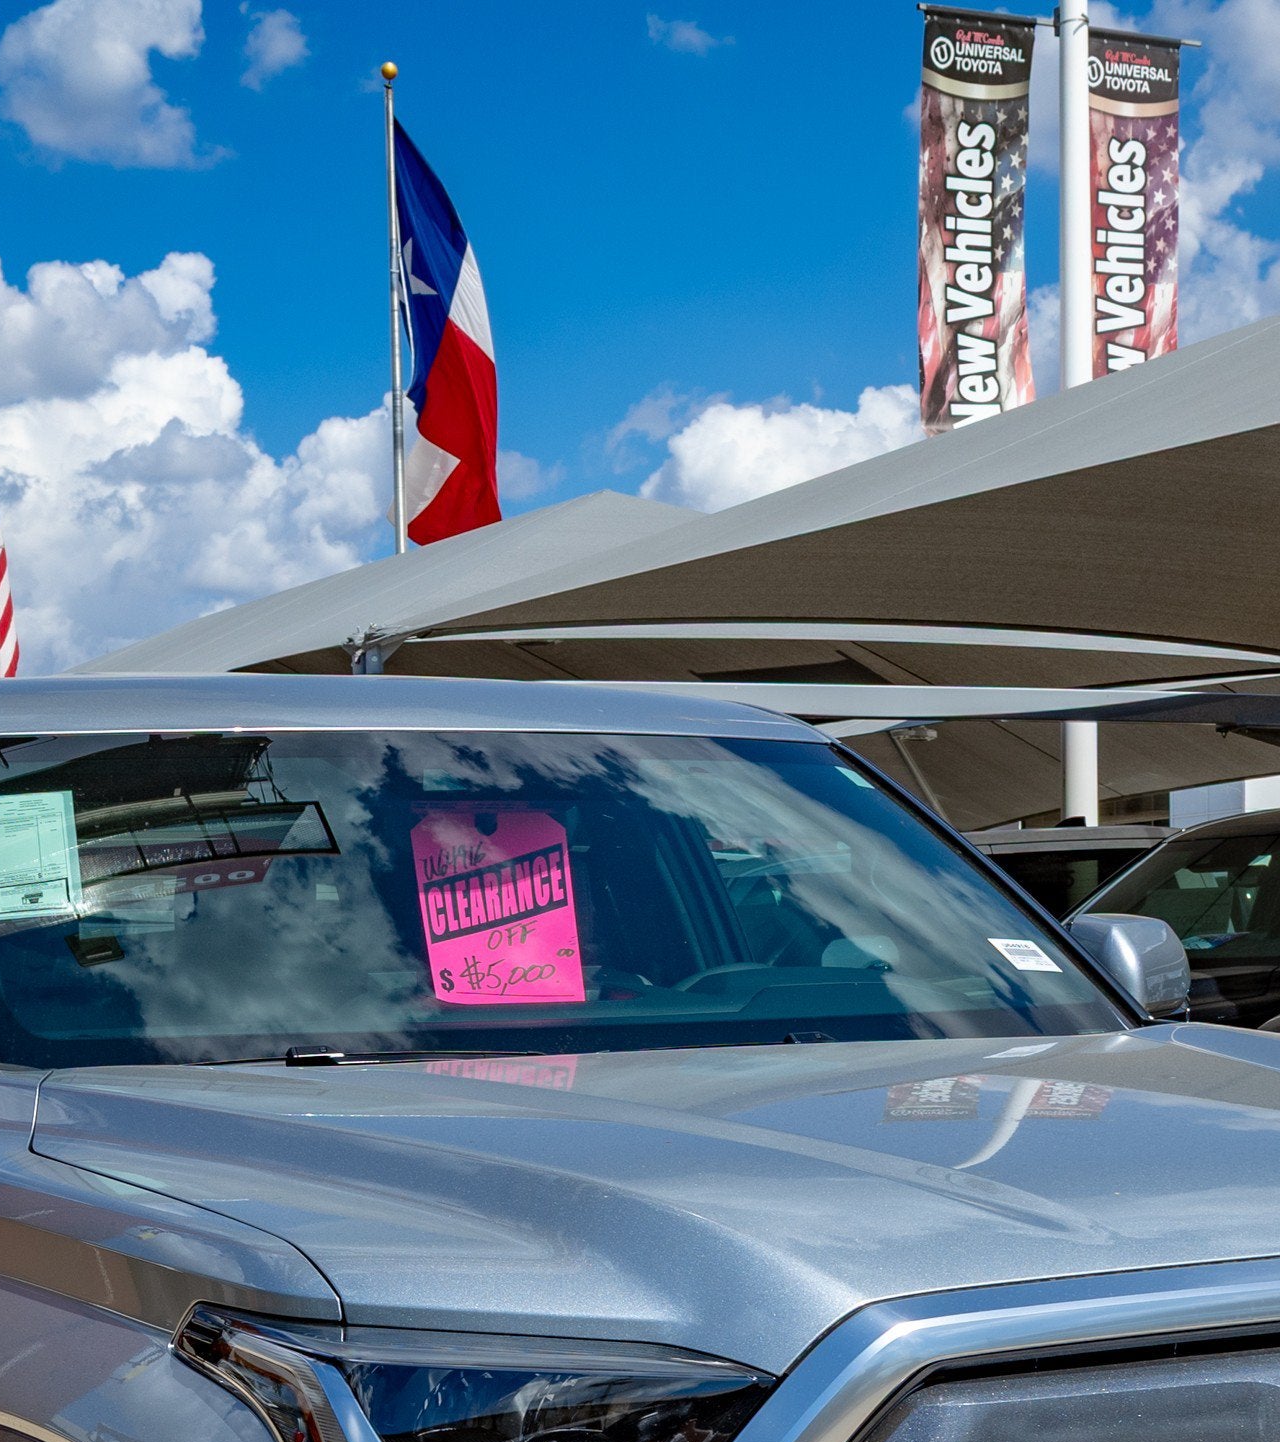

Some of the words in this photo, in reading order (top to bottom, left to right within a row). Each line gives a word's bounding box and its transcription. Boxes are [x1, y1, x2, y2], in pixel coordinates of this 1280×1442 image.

[956, 41, 1026, 63] UNIVERSAL
[955, 56, 1003, 75] TOYOTA
[1105, 60, 1172, 82] UNIVERSAL
[1105, 75, 1151, 93] TOYOTA
[945, 120, 997, 325] Vehicles
[1095, 136, 1148, 334] Vehicles
[427, 851, 565, 936] CLEARANCE
[487, 920, 538, 950] OFF
[439, 968, 455, 993] $
